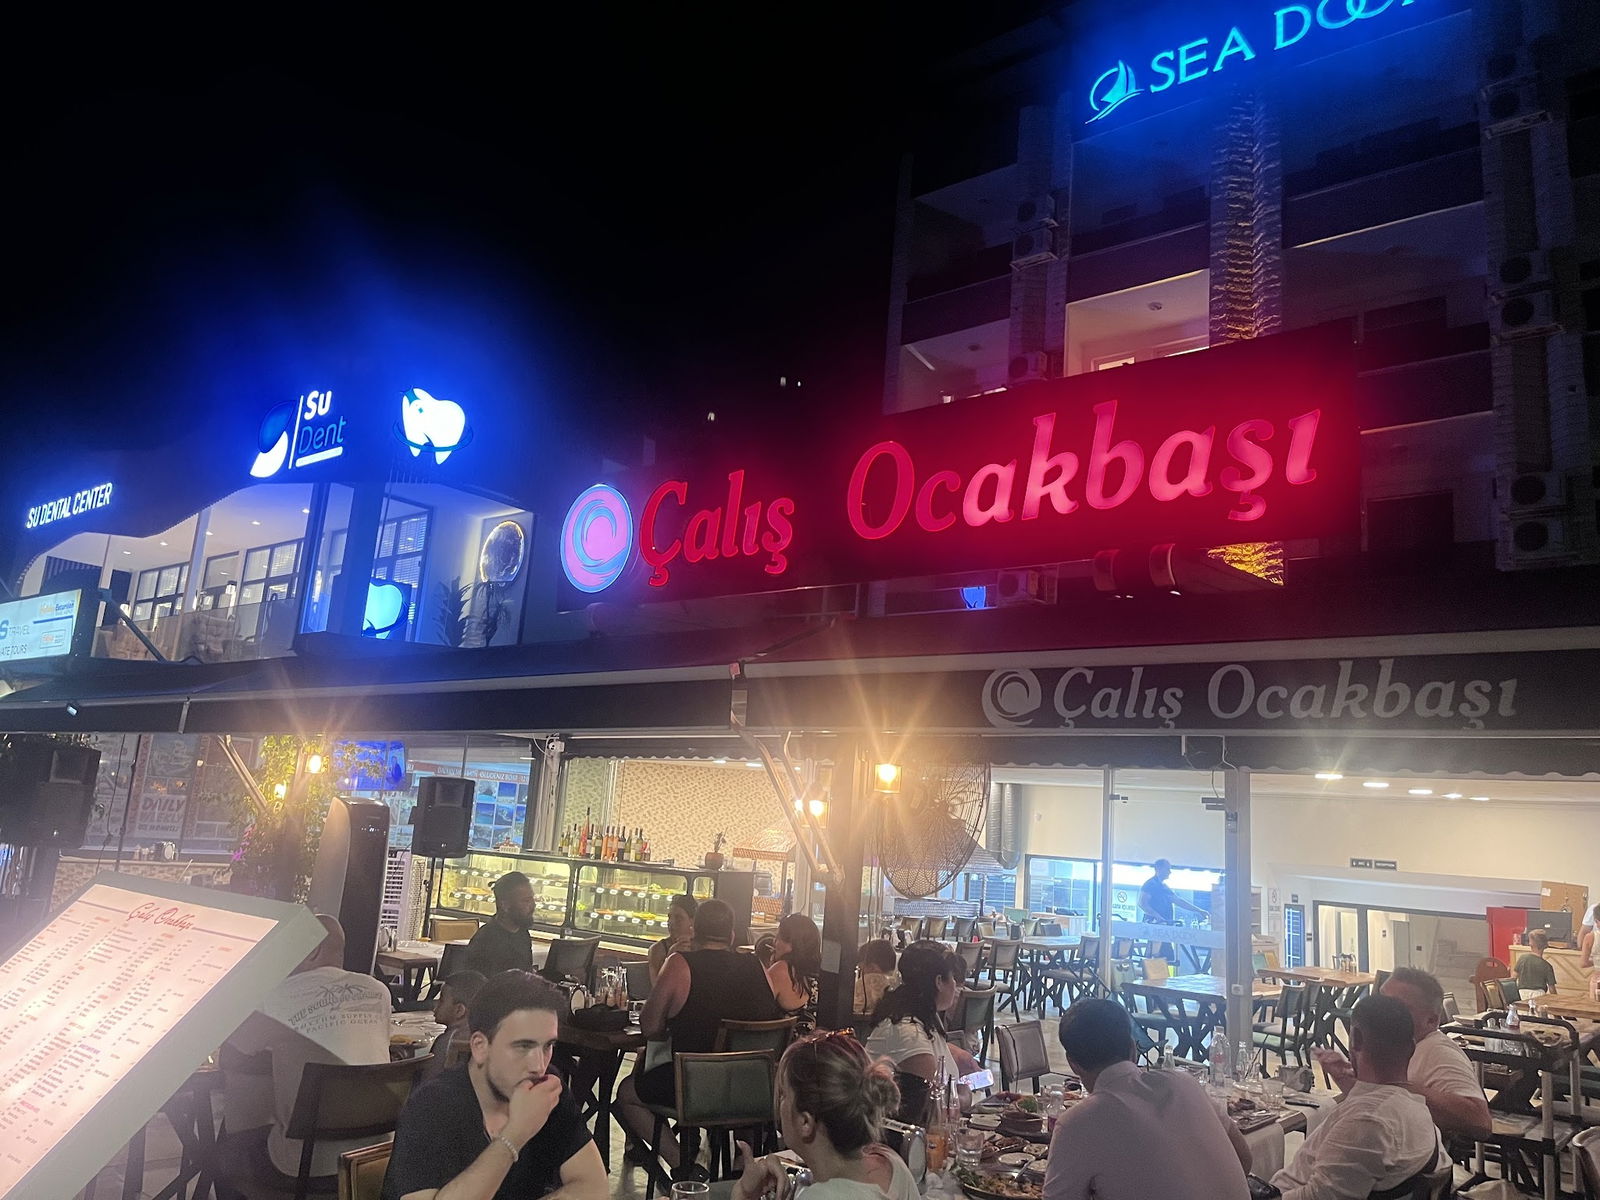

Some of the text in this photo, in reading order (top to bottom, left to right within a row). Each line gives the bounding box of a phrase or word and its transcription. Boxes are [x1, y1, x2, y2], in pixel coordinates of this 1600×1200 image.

[1149, 26, 1256, 93] SEA
[303, 389, 333, 420] SU
[298, 415, 346, 454] Dent
[26, 482, 113, 529] SU DENTAL CENTER
[639, 400, 1321, 587] Çalış Ocakbaşı
[1053, 658, 1518, 730] Çalış Ocakbaşı
